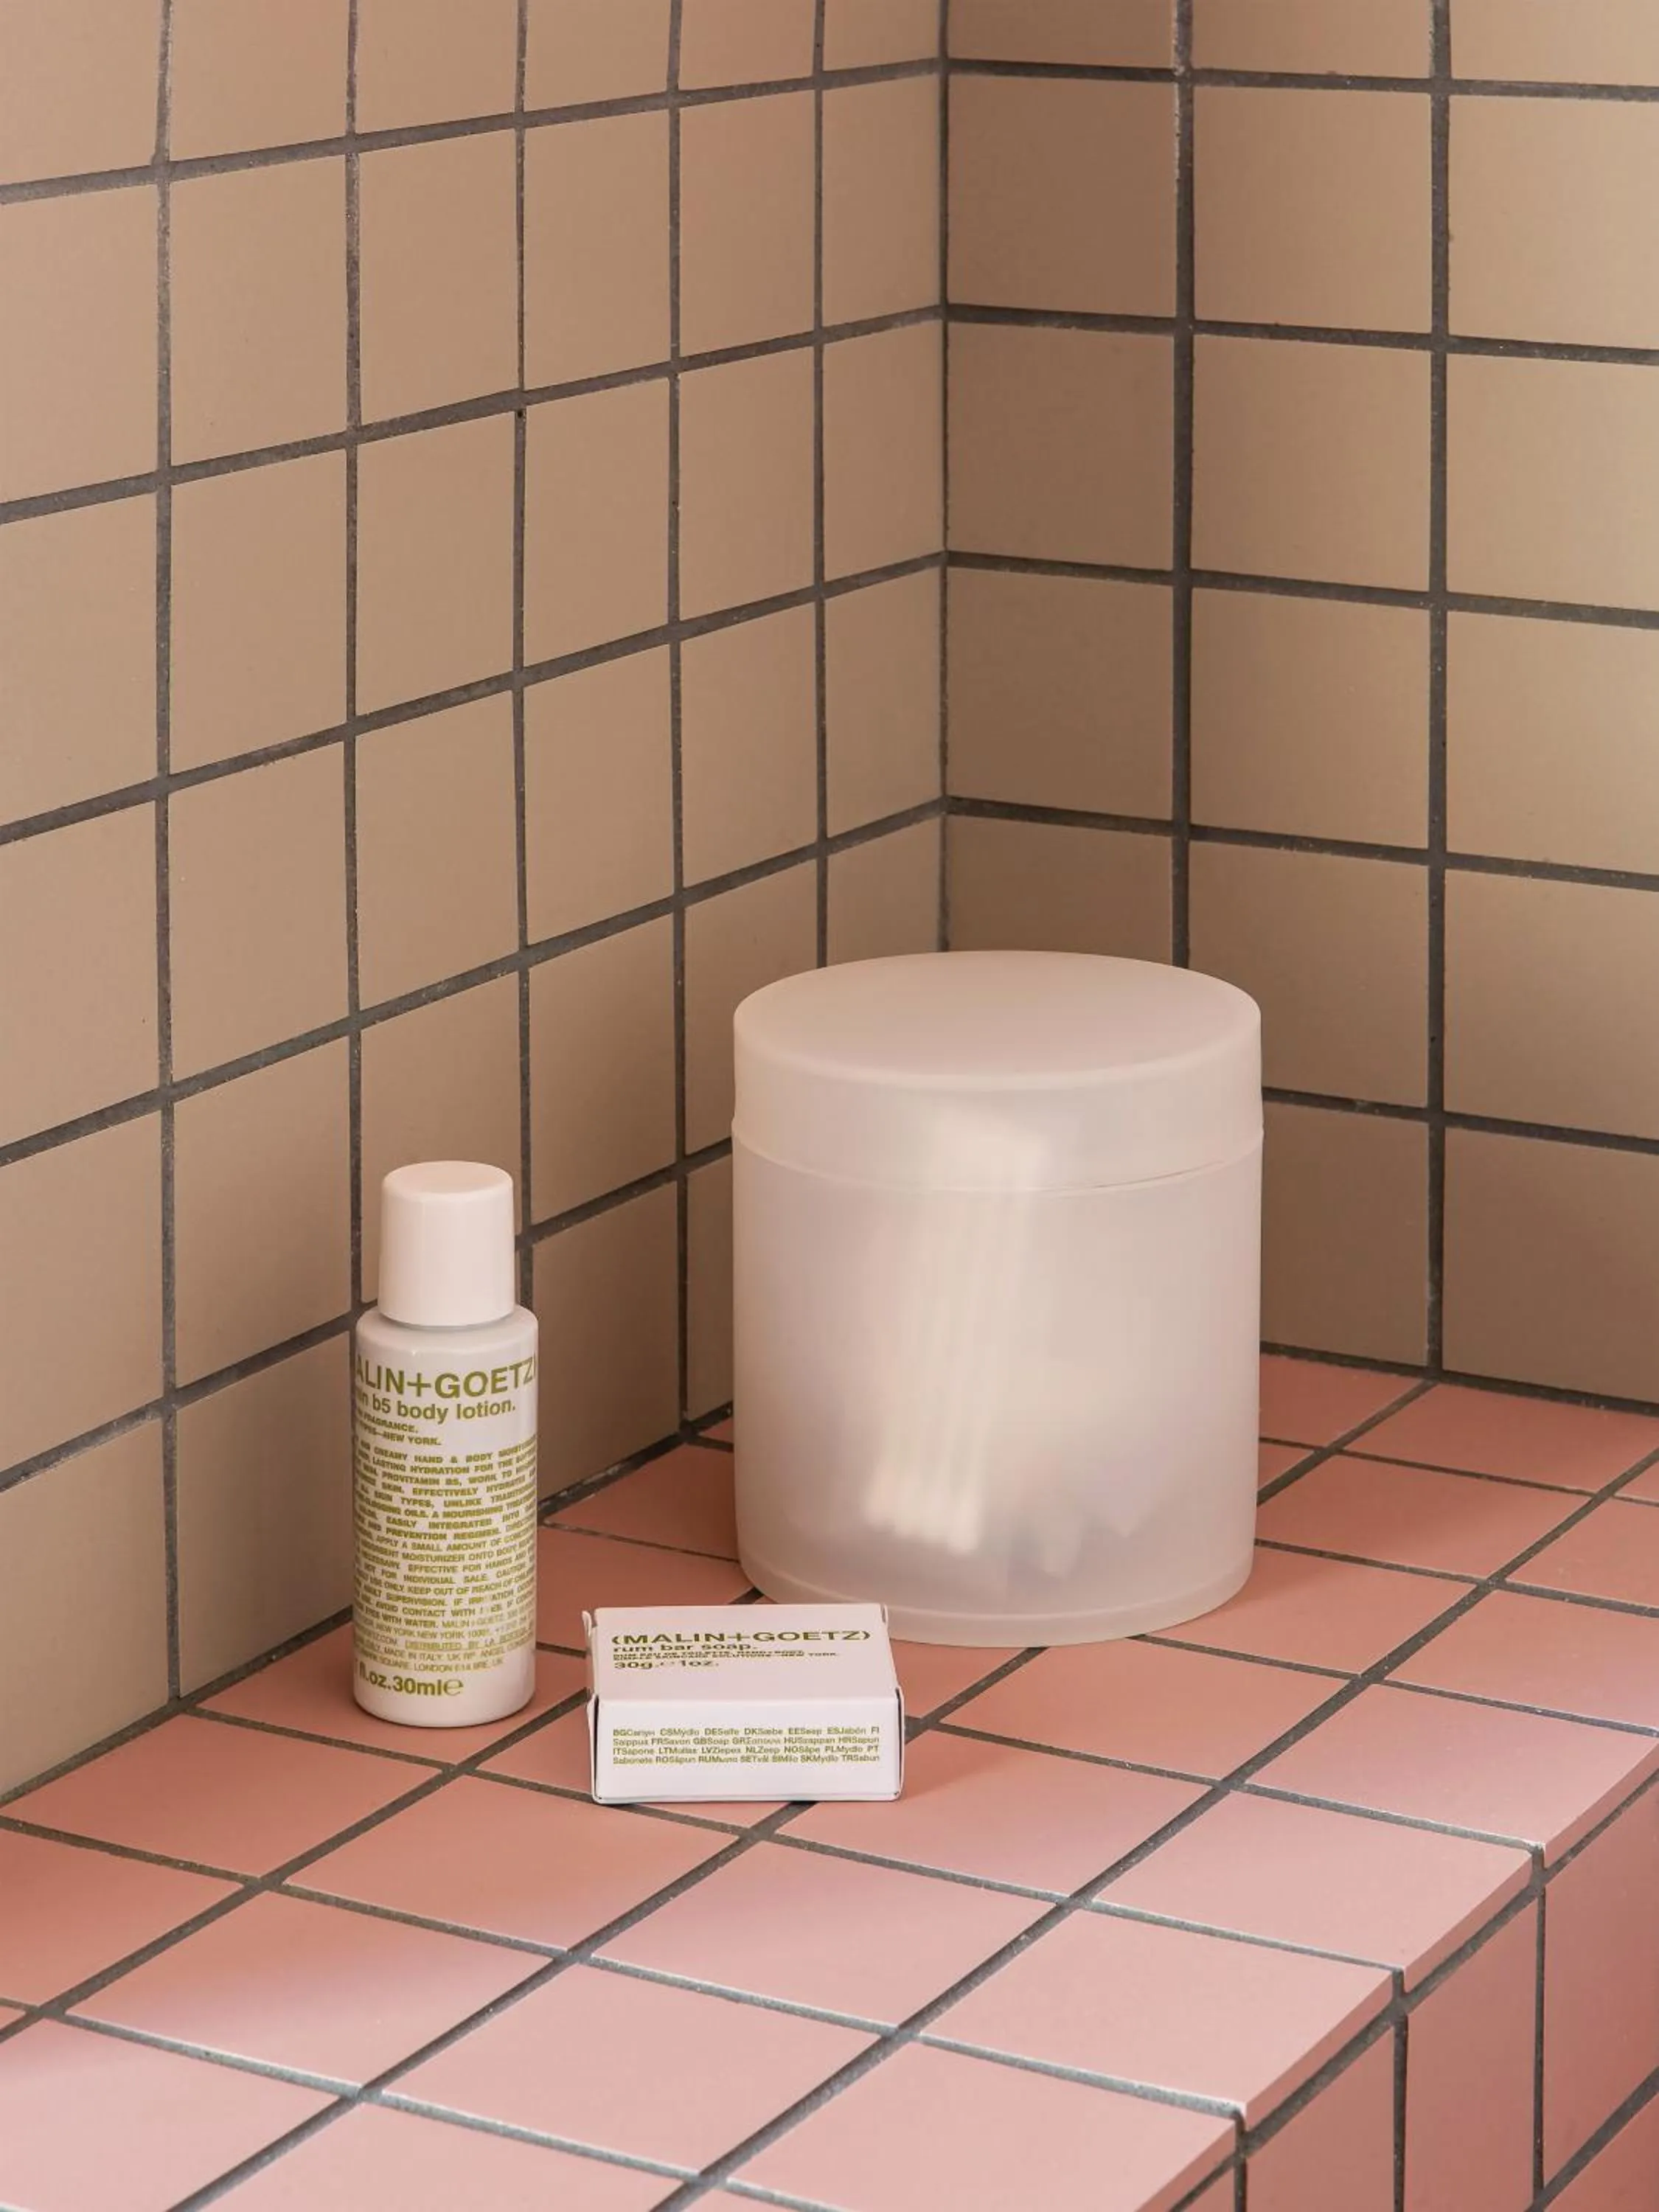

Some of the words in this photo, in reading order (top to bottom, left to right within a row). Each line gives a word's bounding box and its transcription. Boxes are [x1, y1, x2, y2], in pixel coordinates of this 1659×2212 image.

[372, 1394, 391, 1414] b5
[397, 1399, 448, 1425] body
[456, 1399, 515, 1420] lotion.
[611, 1630, 871, 1645] (MALIN+GOETZ)
[701, 1644, 758, 1652] soap.
